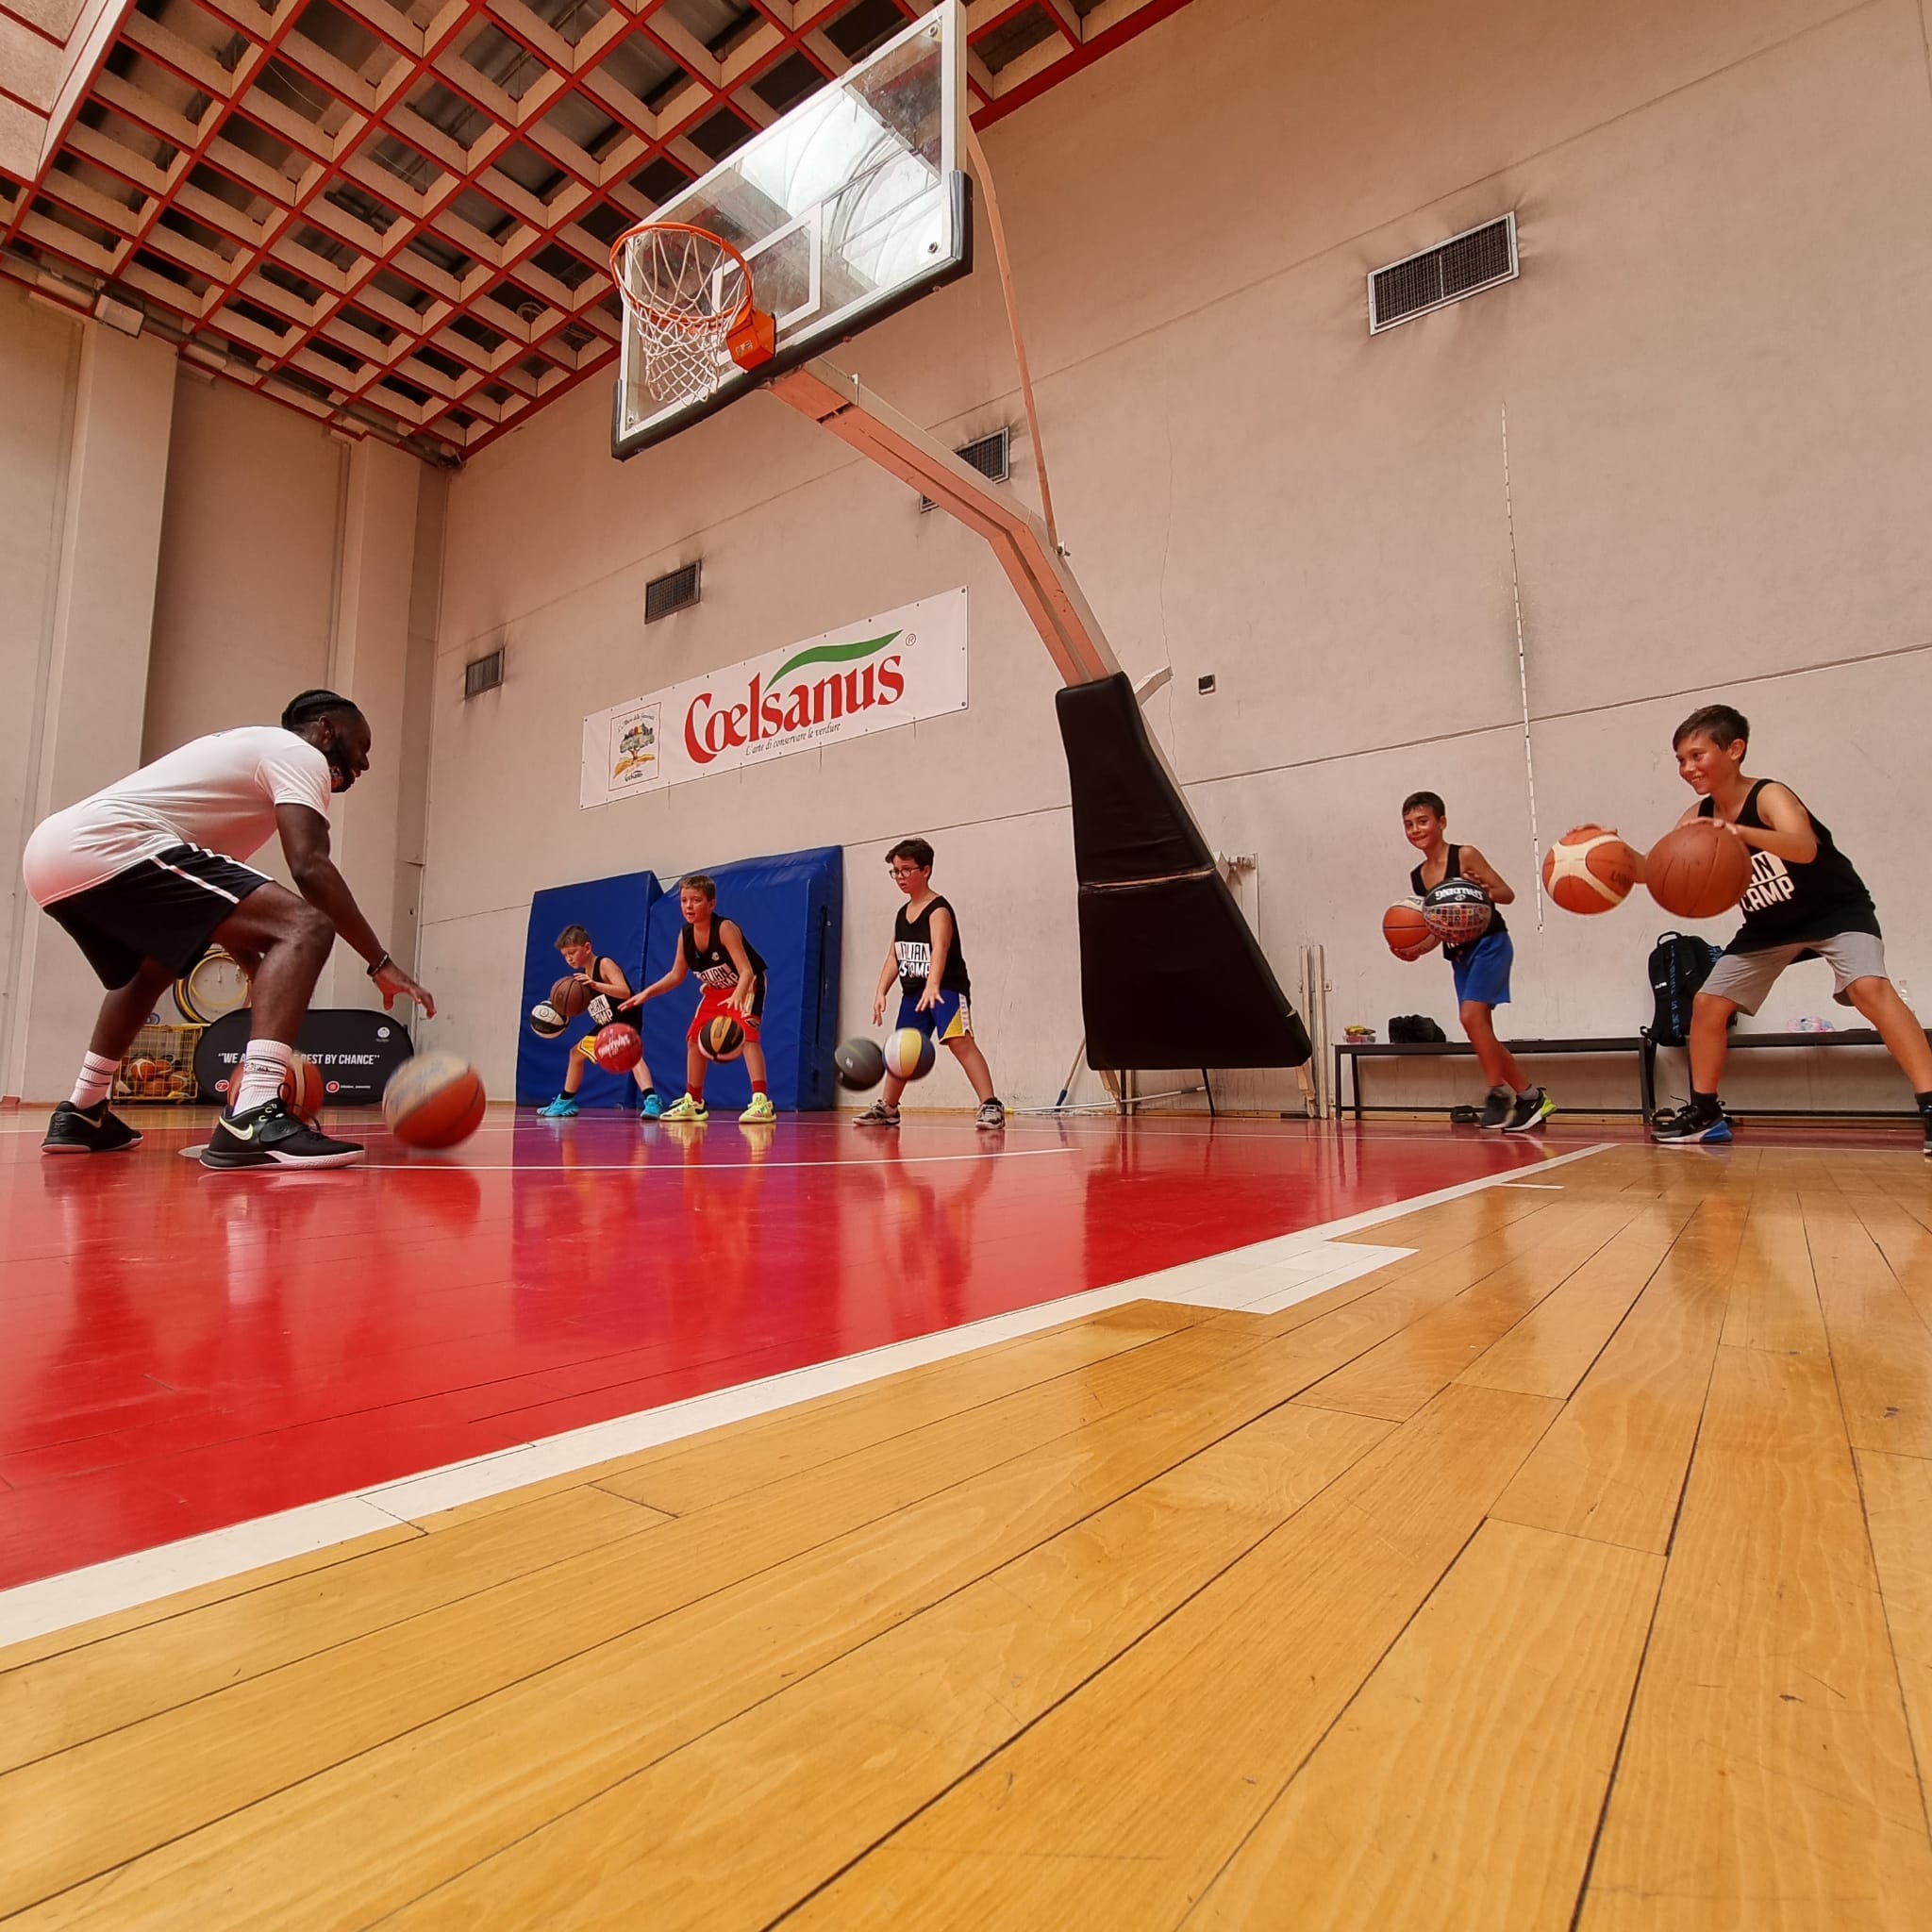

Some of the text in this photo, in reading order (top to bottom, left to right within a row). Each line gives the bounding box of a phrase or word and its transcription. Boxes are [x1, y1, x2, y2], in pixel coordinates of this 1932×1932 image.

[745, 722, 841, 756] L'arte di conservare le verdure
[325, 1054, 339, 1065] BY
